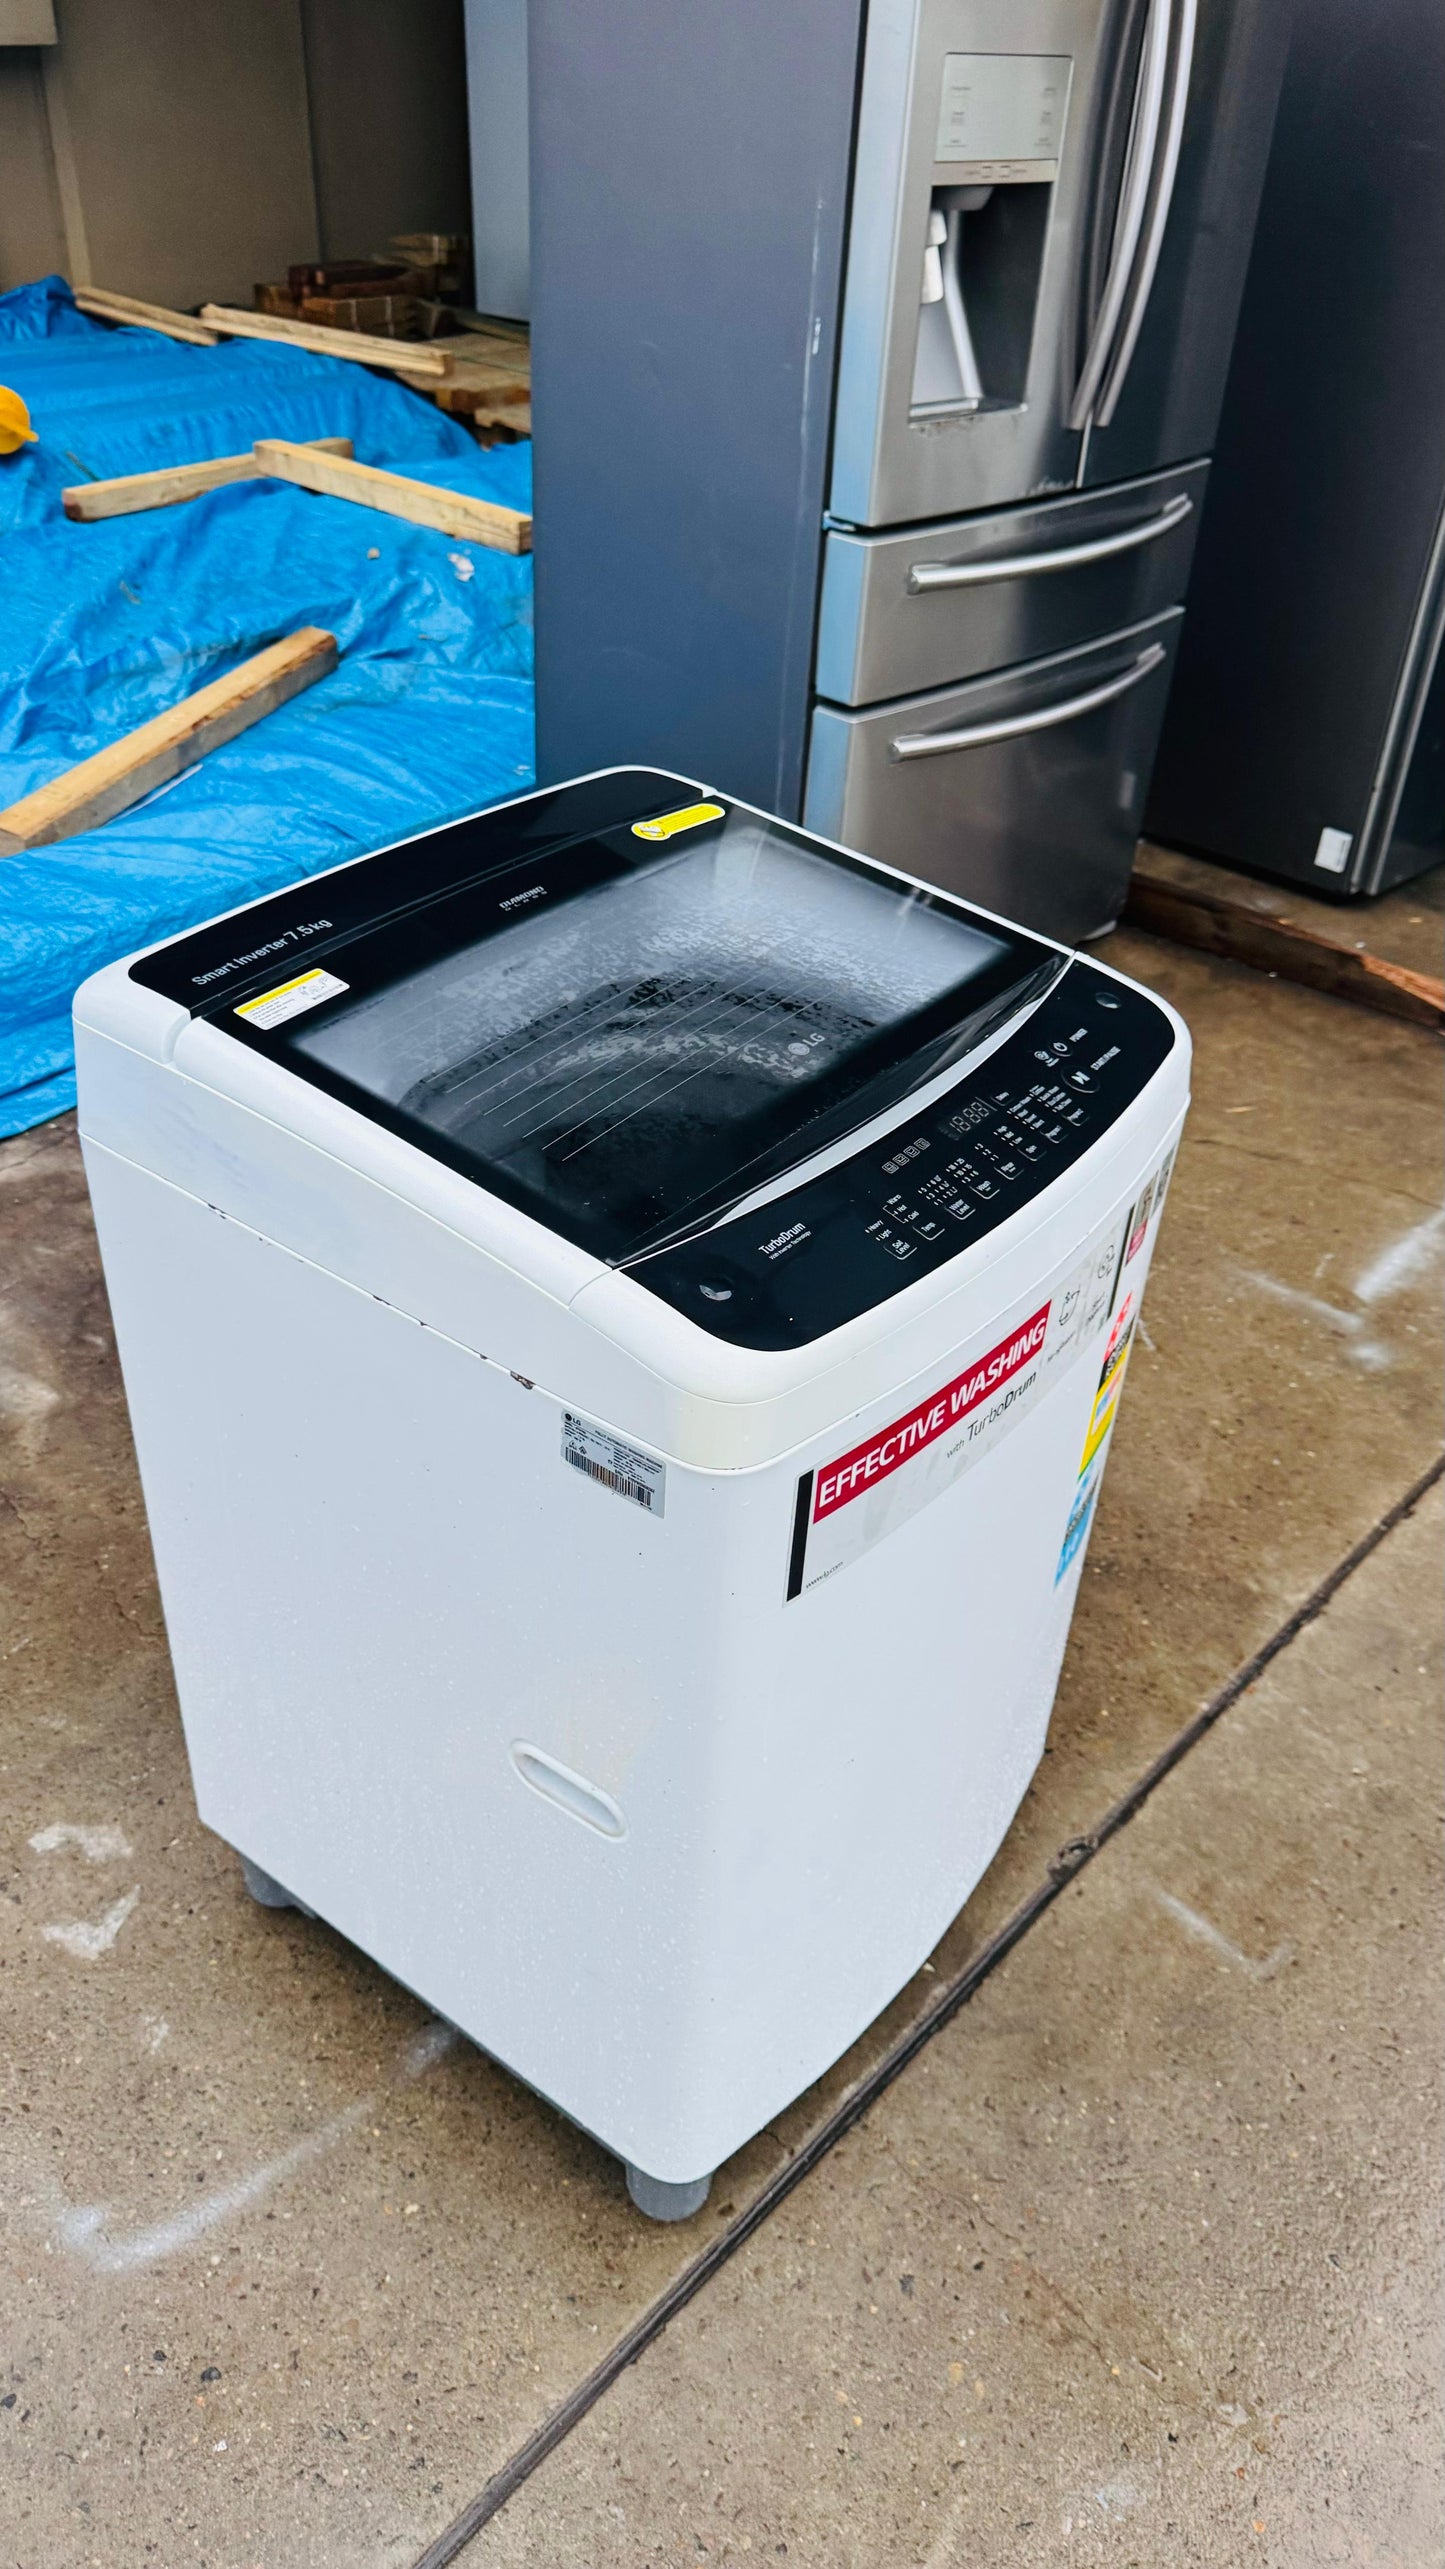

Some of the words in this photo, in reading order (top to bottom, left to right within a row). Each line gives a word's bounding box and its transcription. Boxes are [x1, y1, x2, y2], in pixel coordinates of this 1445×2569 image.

[499, 886, 544, 909] DIAMOND
[191, 961, 239, 985] Smart
[233, 937, 289, 966] Inverter
[802, 1033, 826, 1047] LG
[976, 1181, 991, 1191] Wash
[887, 1194, 902, 1205] Warm
[949, 1199, 965, 1211] Water
[897, 1204, 907, 1213] Hot
[956, 1203, 970, 1215] Level
[908, 1210, 919, 1221] Cold
[868, 1220, 884, 1231] Heavy
[758, 1223, 806, 1254] TurboDrum
[879, 1229, 892, 1240] Light
[892, 1239, 904, 1249] Soil
[896, 1242, 910, 1255] Level
[818, 1399, 947, 1509] EFFECTIVE
[951, 1316, 1047, 1415] WASHING
[947, 1440, 964, 1458] with
[967, 1371, 1037, 1440] TurboDrum
[572, 1417, 581, 1426] LG
